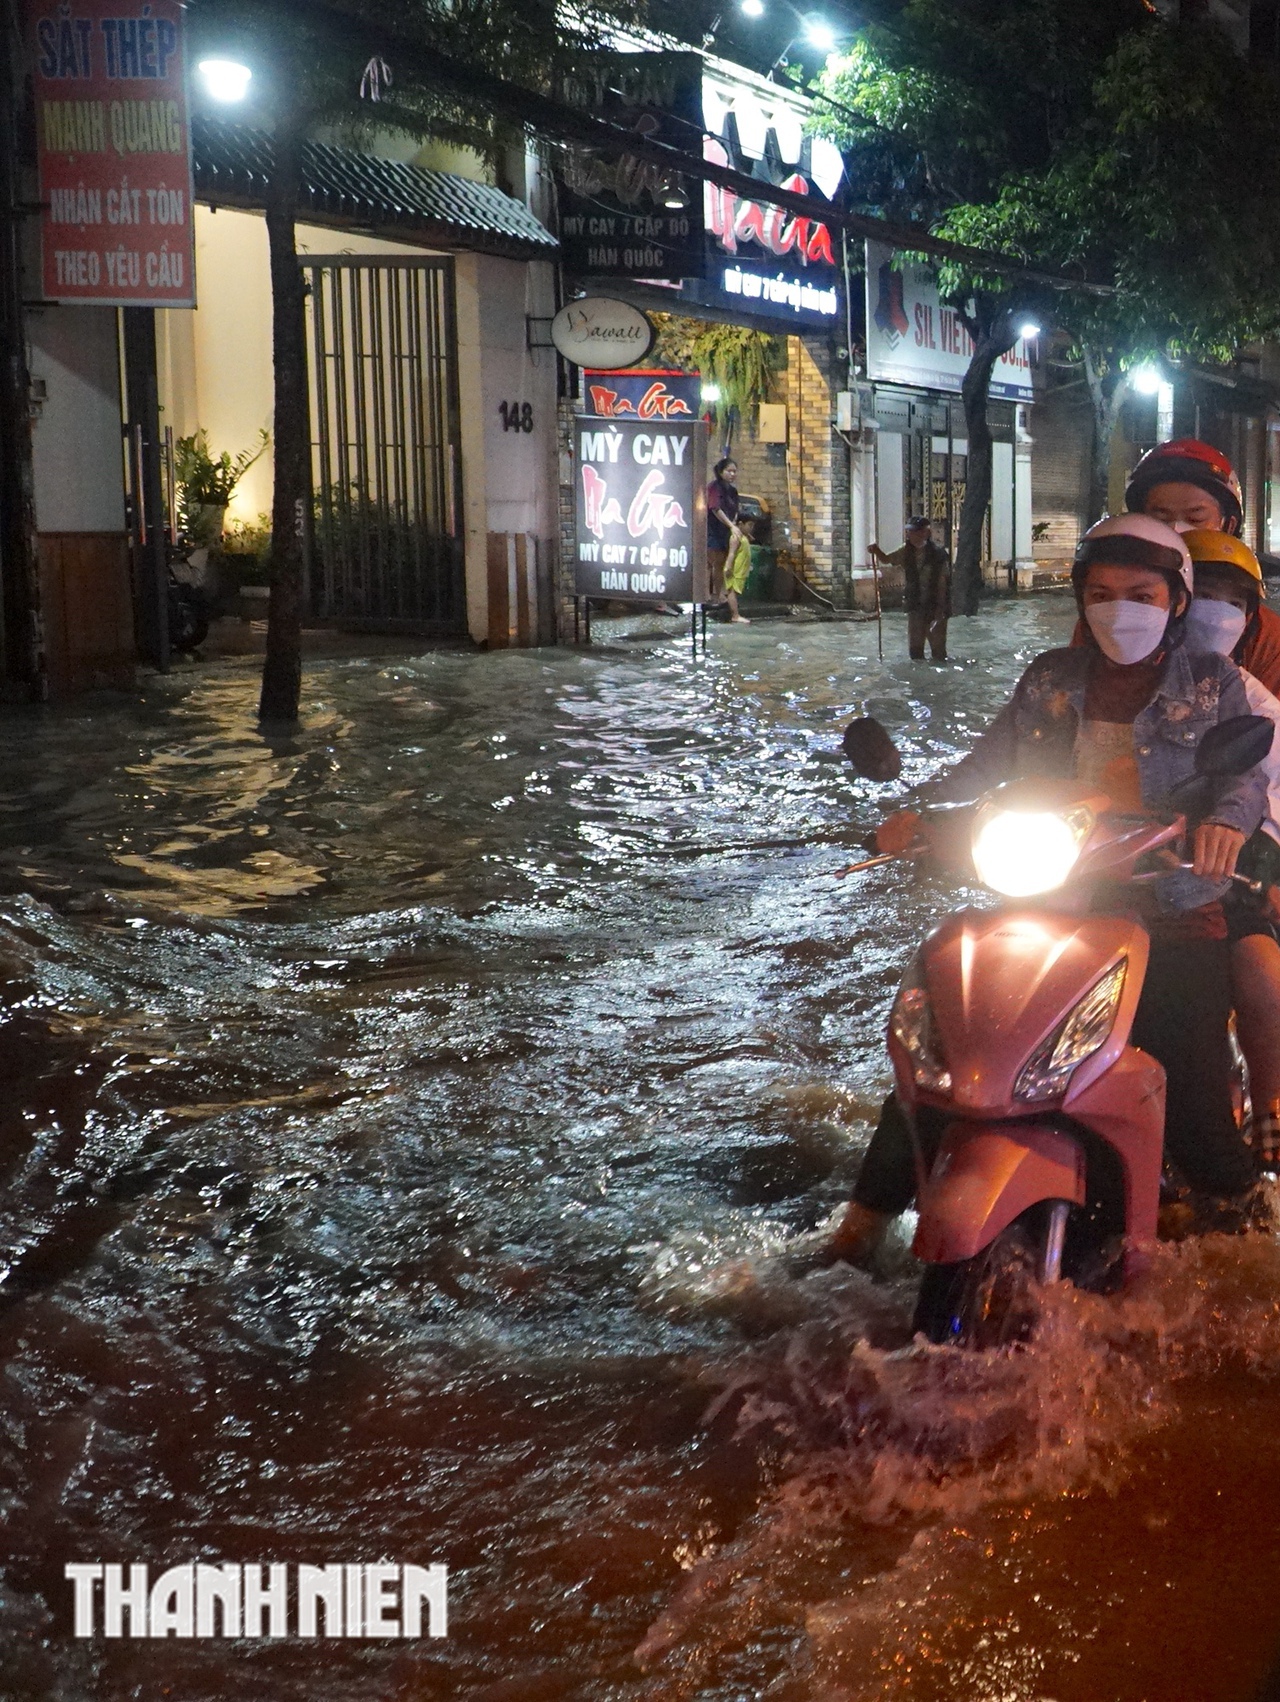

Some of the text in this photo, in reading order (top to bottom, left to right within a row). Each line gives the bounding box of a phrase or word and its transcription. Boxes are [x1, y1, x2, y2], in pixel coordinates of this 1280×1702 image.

[101, 4, 176, 79] THÉP
[43, 100, 181, 162] MẠNH QUANG
[51, 181, 102, 233] NHẬN
[146, 181, 184, 226] TÔN
[54, 251, 101, 286] THEO
[105, 243, 140, 287] YÊU
[914, 302, 936, 349] SIL
[498, 401, 533, 433] 148
[581, 425, 689, 465] MỲ CAY
[580, 540, 688, 572] MỲ CAY 7 CẤP ĐỘ
[601, 567, 666, 594] HÀN QUỐC
